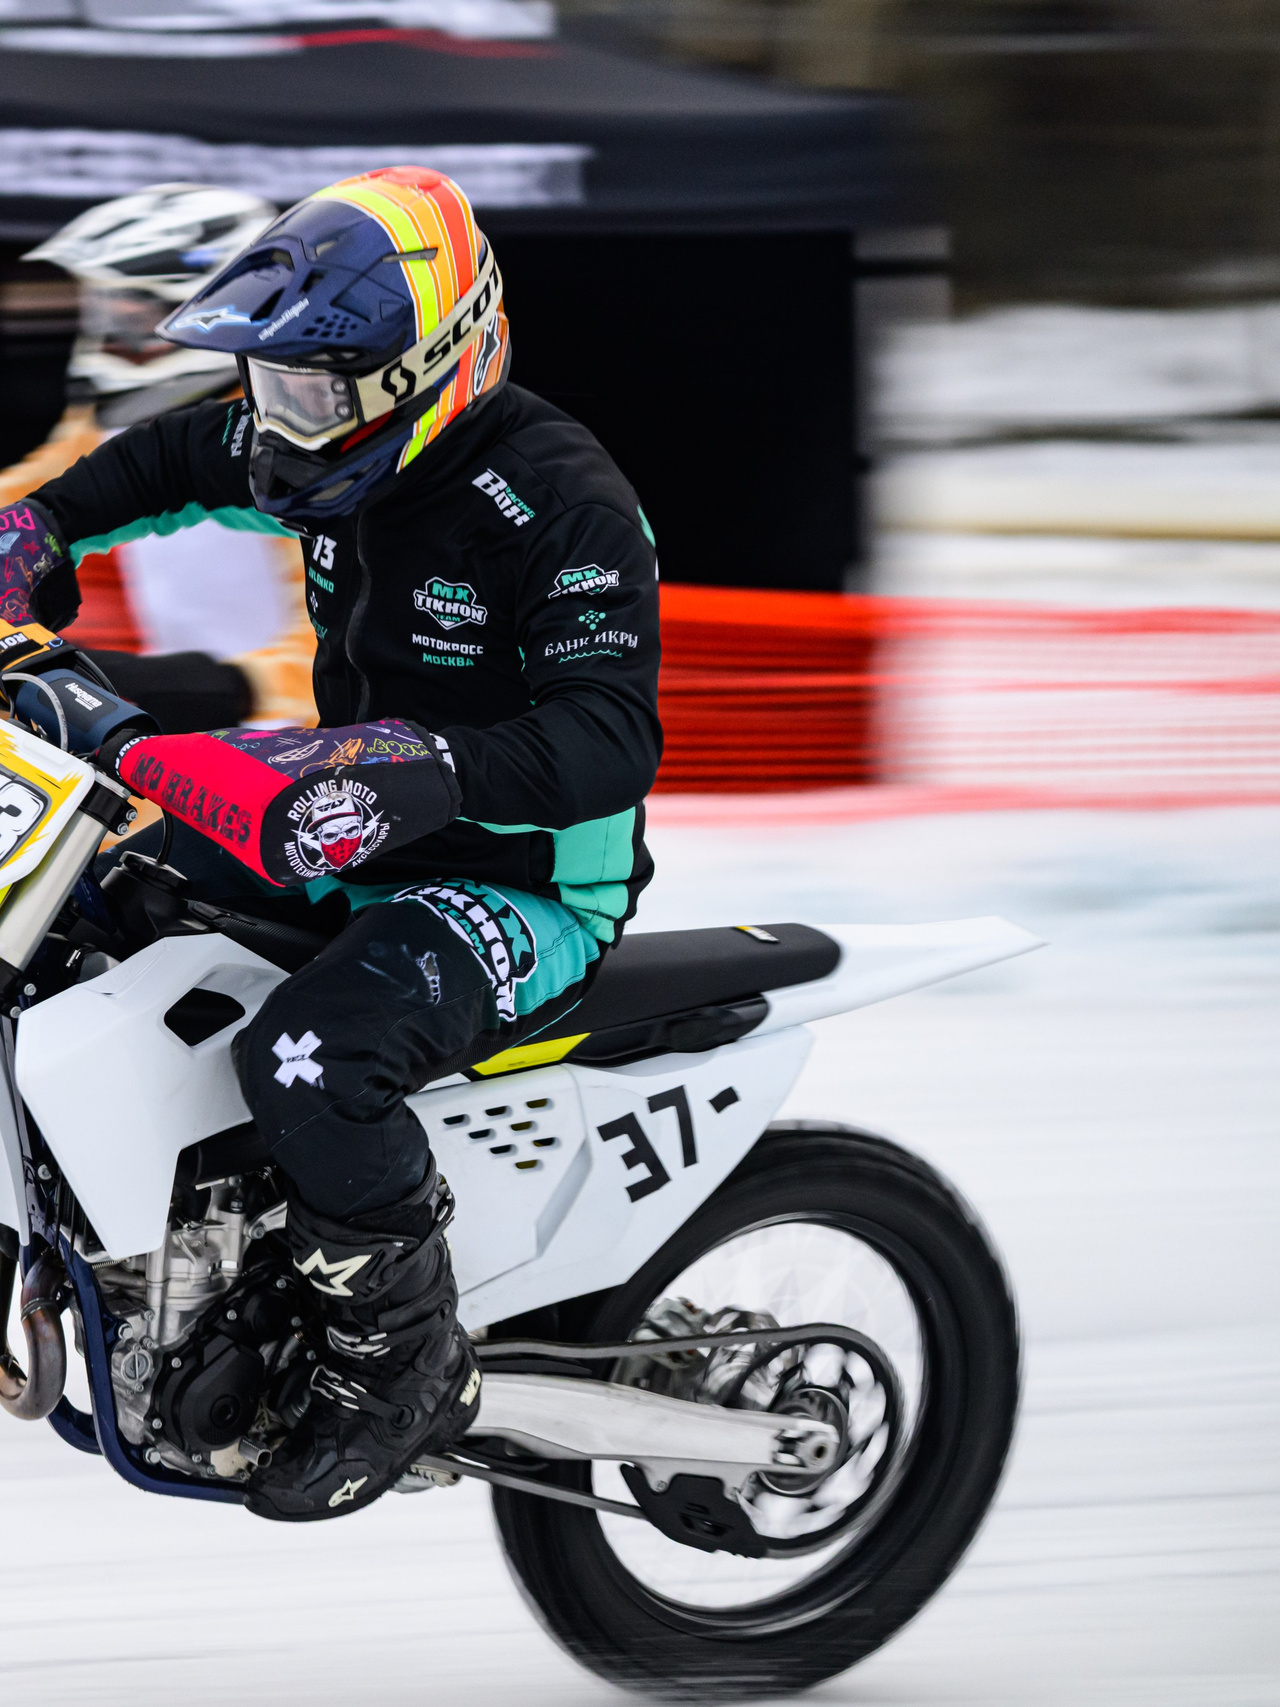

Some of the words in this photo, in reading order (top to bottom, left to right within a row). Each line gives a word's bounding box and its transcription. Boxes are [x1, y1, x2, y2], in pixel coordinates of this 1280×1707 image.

[423, 260, 499, 375] SCOT
[505, 485, 536, 519] RACING
[561, 568, 601, 587] MX
[431, 581, 470, 603] MX
[415, 592, 485, 622] TIKHON
[436, 613, 461, 622] TEAM
[412, 632, 484, 656] МОТОКРОСС
[544, 637, 590, 657] БАНК
[594, 630, 639, 649] ИКРЫ
[422, 652, 474, 667] МОСКВА
[130, 752, 165, 792] NO
[161, 768, 253, 848] BRAKES
[287, 779, 338, 822] ROLLING
[341, 778, 378, 805] MOTO
[437, 901, 486, 956] TEAM
